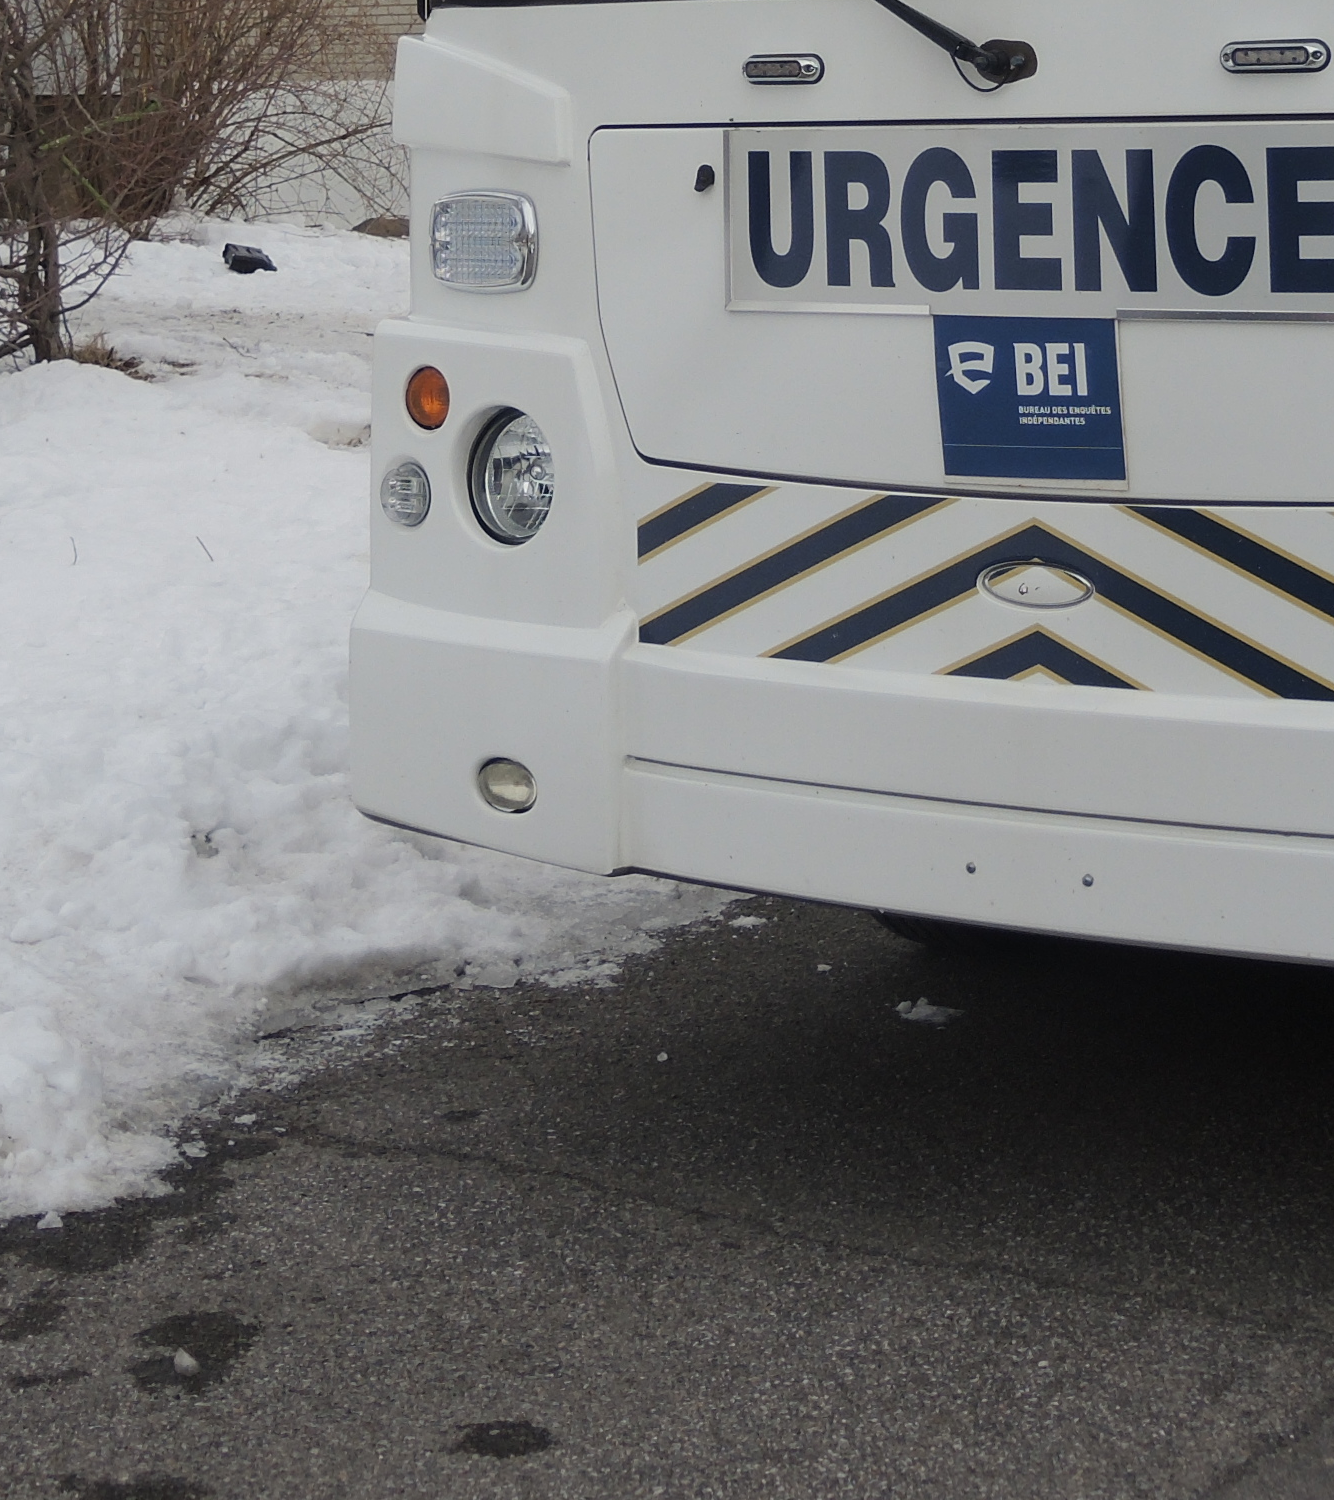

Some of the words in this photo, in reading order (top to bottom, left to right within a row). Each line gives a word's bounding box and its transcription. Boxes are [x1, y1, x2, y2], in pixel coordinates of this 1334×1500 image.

[1012, 342, 1088, 396] BEI
[1018, 405, 1051, 414] BUREAU
[1051, 406, 1068, 414] DES
[1068, 404, 1112, 415] ENQUÊTES
[1019, 414, 1086, 425] INDÉPENDANTES
